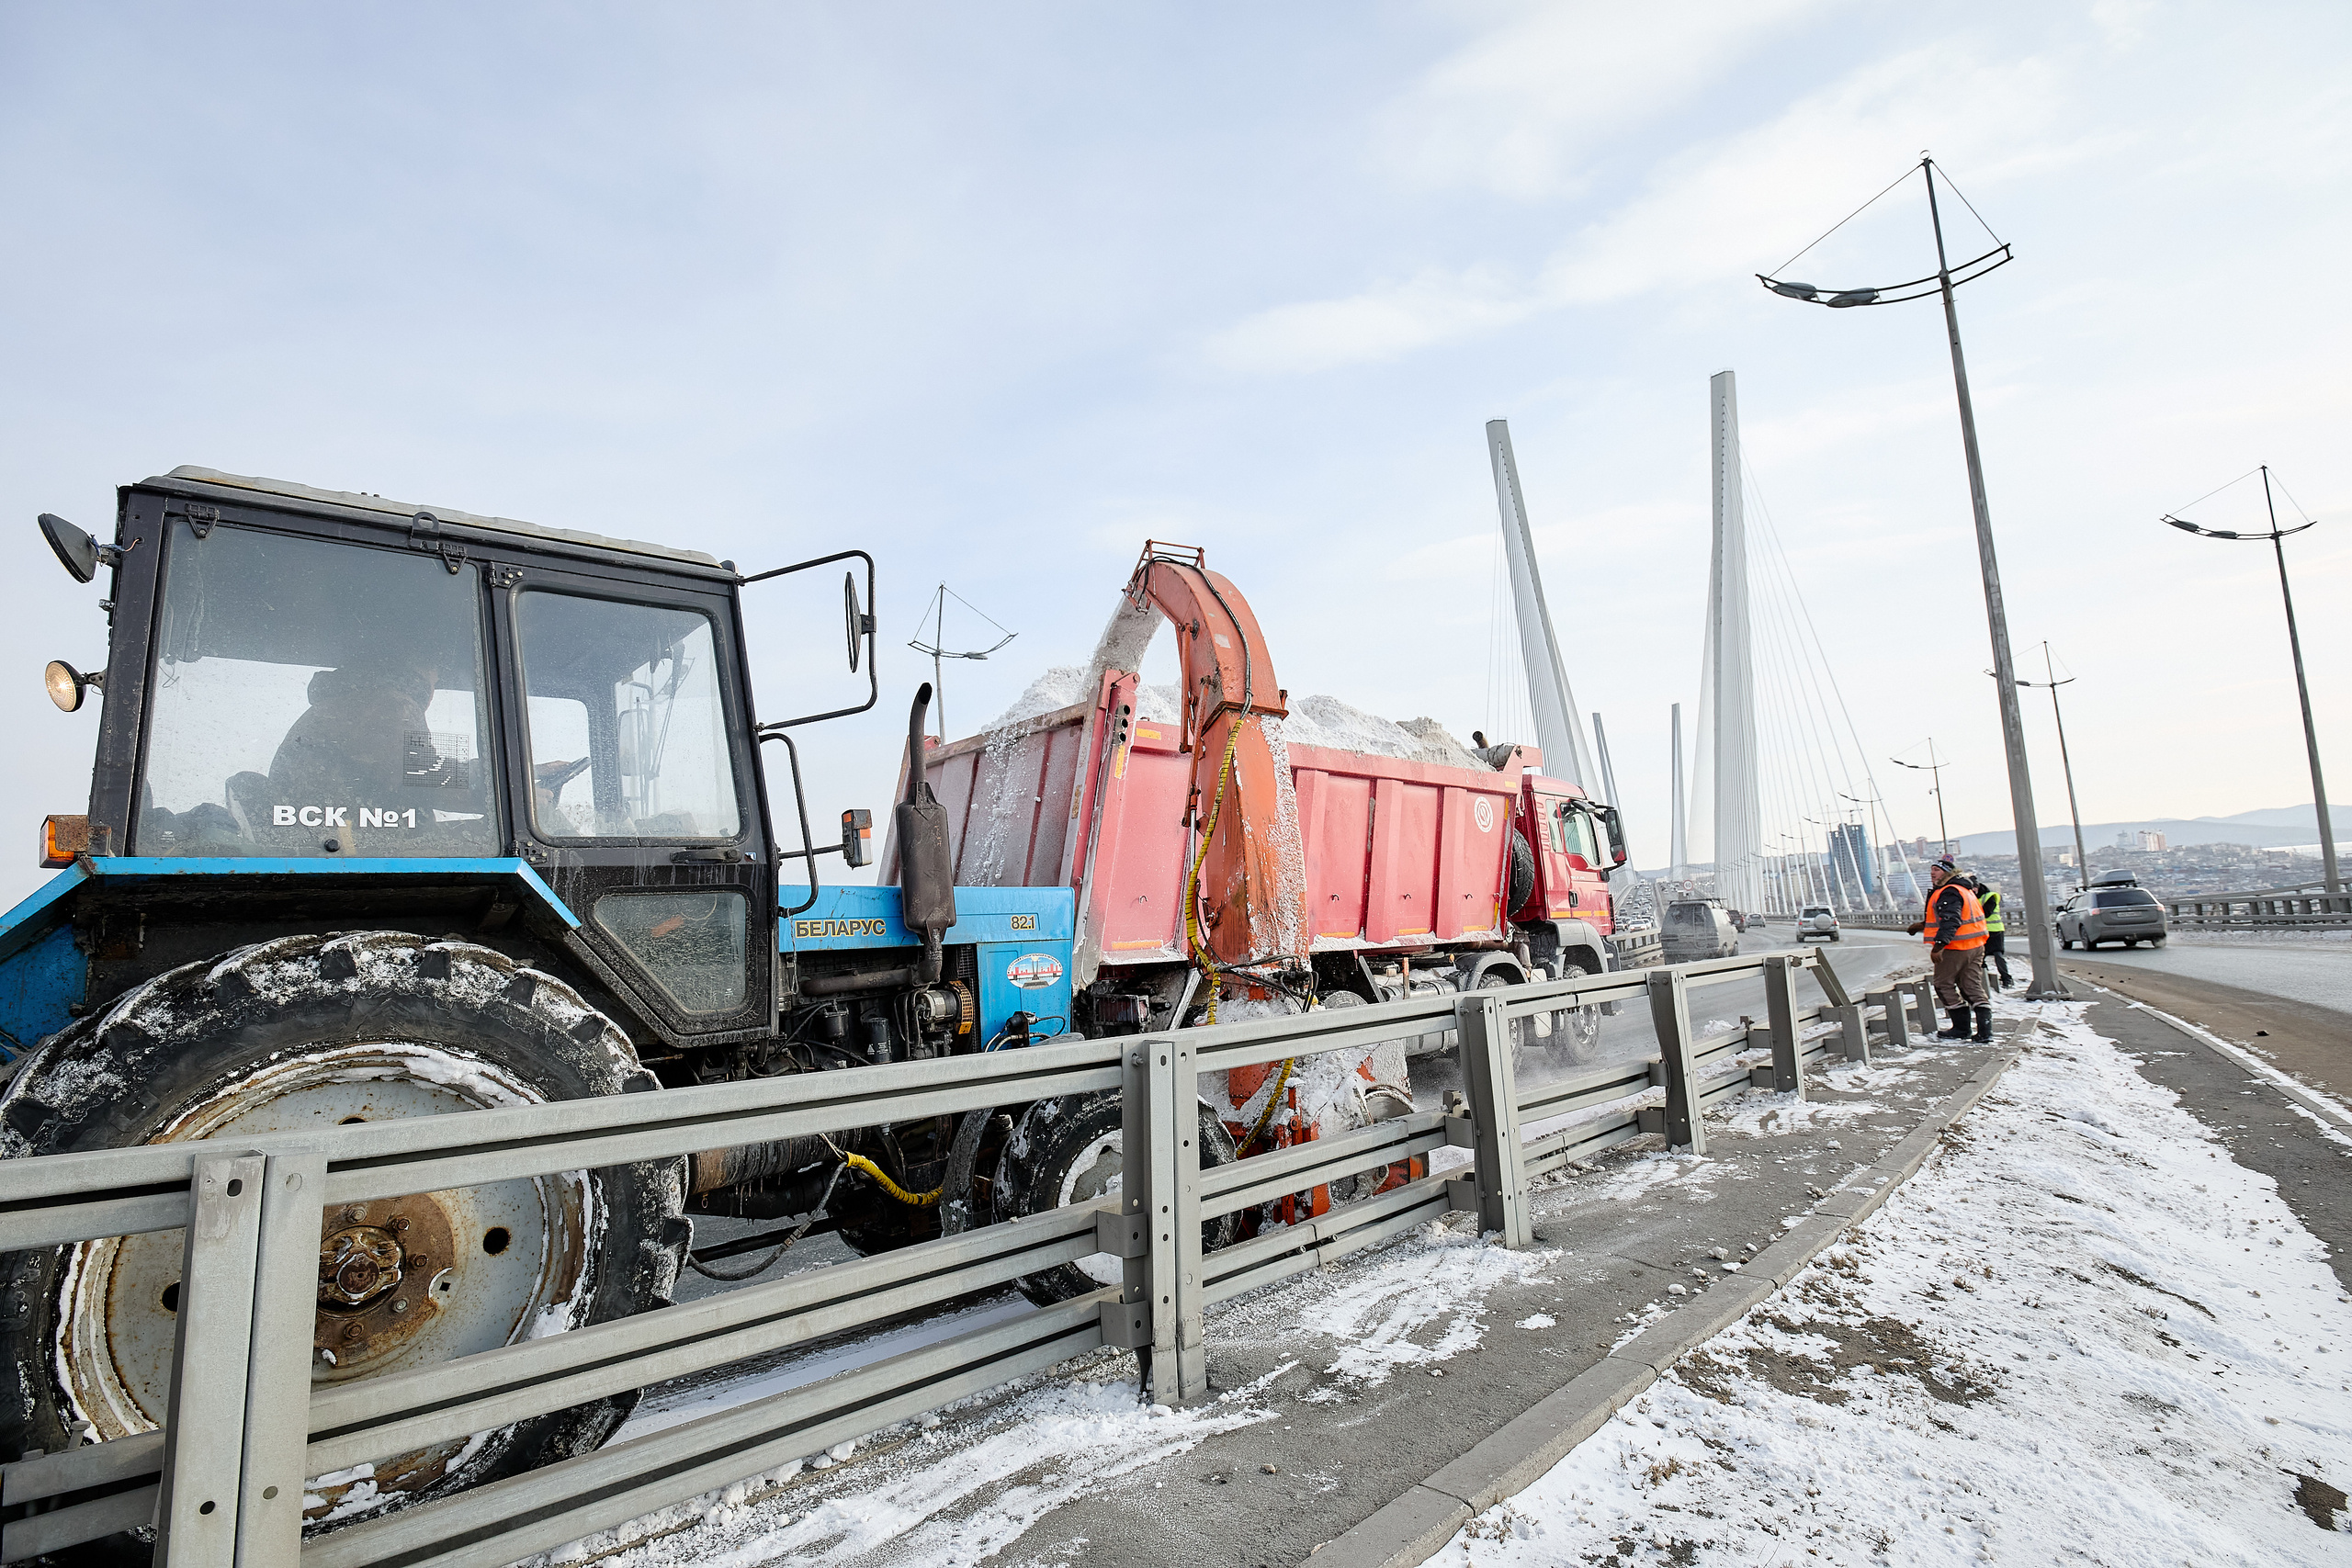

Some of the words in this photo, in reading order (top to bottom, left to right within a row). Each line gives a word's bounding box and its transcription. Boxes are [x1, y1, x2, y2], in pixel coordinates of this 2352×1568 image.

[273, 805, 347, 827] ВСК
[359, 807, 416, 829] №1
[796, 919, 886, 938] БЕЛАРУС
[1011, 914, 1035, 930] 82.1
